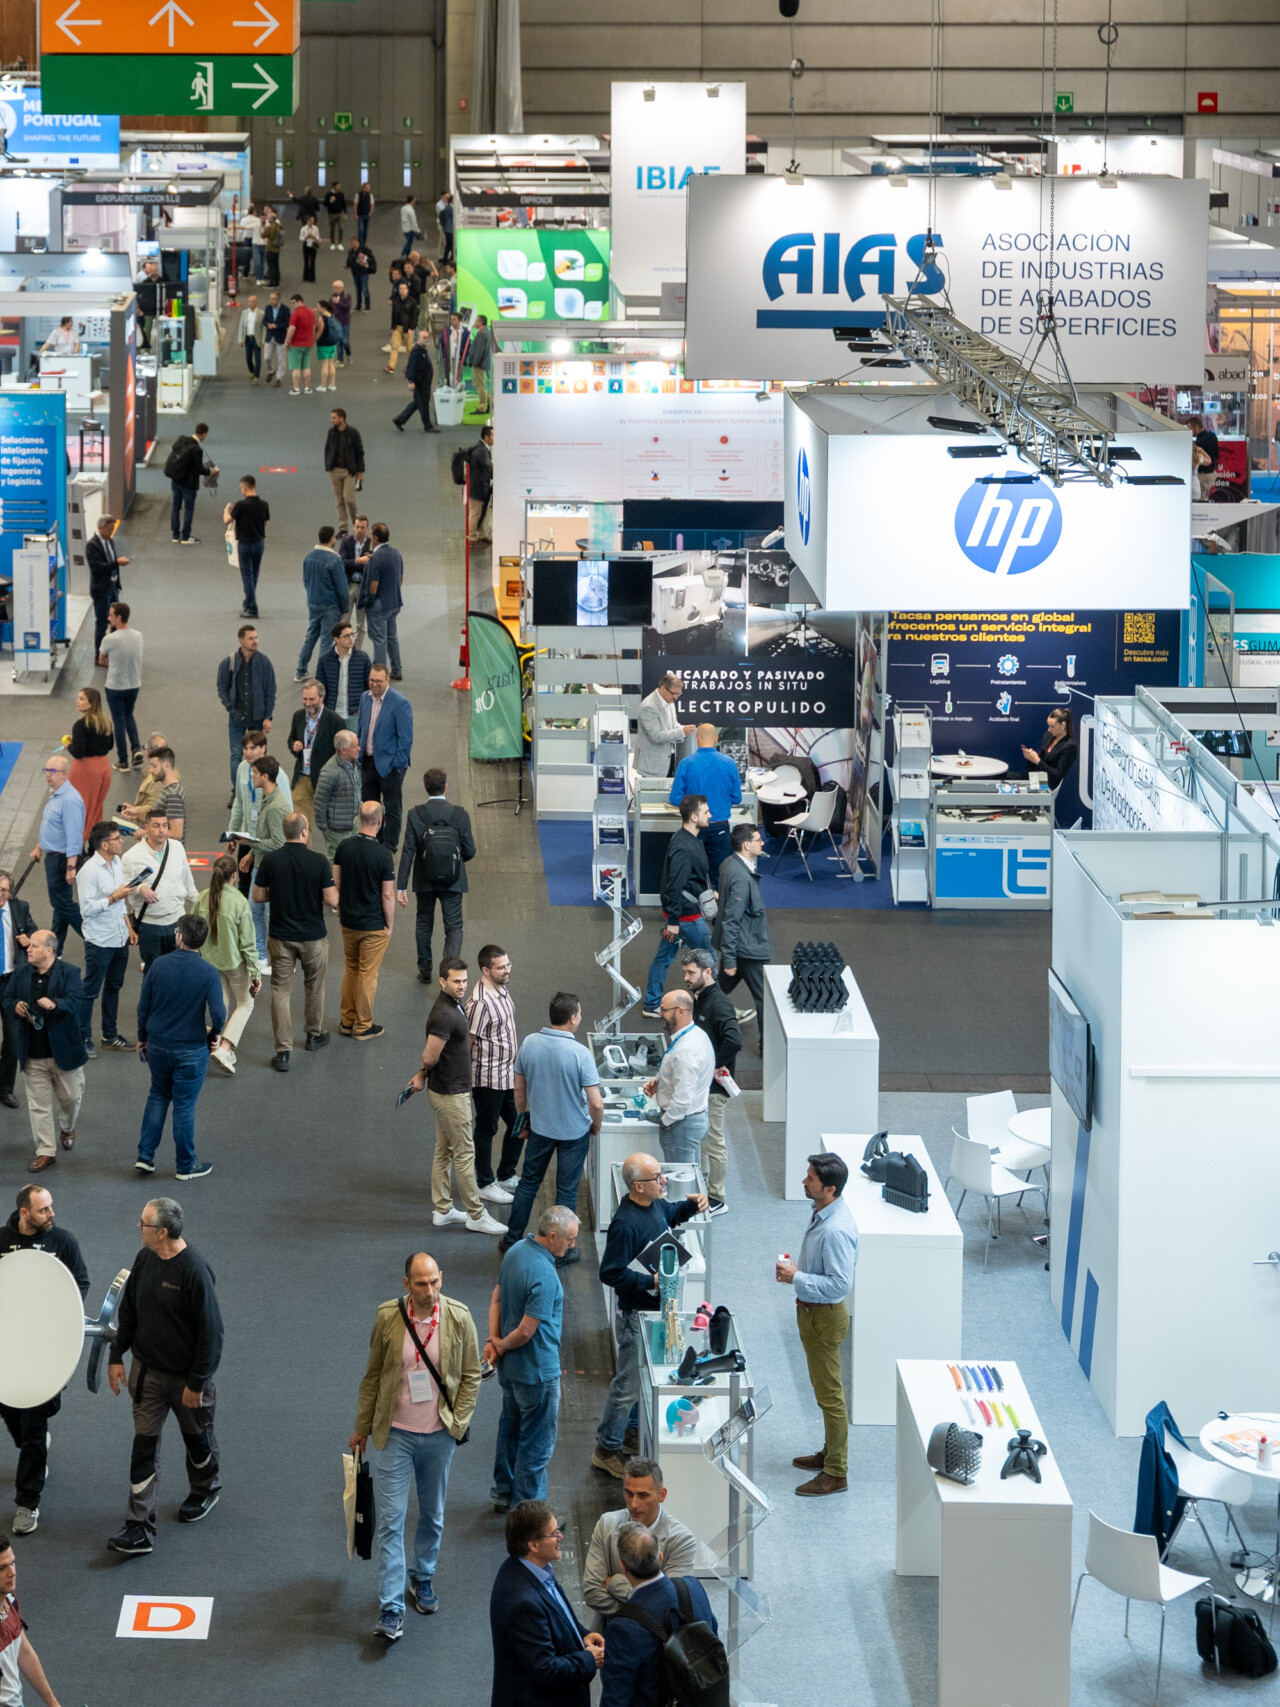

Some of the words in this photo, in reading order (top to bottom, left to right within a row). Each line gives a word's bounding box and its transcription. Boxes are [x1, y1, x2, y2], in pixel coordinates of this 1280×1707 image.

[23, 115, 101, 127] PORTUGAL
[23, 134, 52, 142] SHAPING
[55, 134, 71, 142] THE
[74, 134, 101, 142] FUTURE
[95, 195, 133, 203] EUROPLASTIC
[134, 195, 165, 203] INYECCION
[982, 228, 1131, 252] ASOCIACIÓN
[763, 232, 946, 302] AIAS
[982, 262, 1013, 279] DE
[1020, 262, 1164, 281] INDUSTRIAS
[981, 289, 1012, 306] DE
[1019, 289, 1151, 309] ACABADOS
[980, 317, 1012, 334] DE
[1019, 317, 1177, 337] SUPERFICIES
[1, 436, 44, 444] Soluciones
[1, 446, 48, 456] inteligentes
[1, 456, 10, 465] de
[12, 456, 43, 466] fijación,
[1, 467, 41, 477] ingeniería
[7, 476, 43, 487] logística.
[965, 471, 1054, 575] hp
[891, 612, 931, 622] Tacsa
[935, 612, 1007, 623] pensamos
[1011, 612, 1028, 622] en
[1032, 611, 1074, 623] global
[885, 622, 956, 632] ofrecemos
[959, 622, 978, 632] un
[981, 621, 1035, 632] servicio
[1039, 621, 1092, 634] integral
[905, 632, 967, 641] nuestros
[970, 632, 1026, 642] clientes
[1124, 649, 1154, 657] Descubre
[1155, 649, 1170, 657] más
[1133, 655, 1168, 663] tacsa.com
[743, 670, 751, 680] Y
[757, 670, 826, 680] PASIVADO
[684, 681, 752, 690] TRABAJOS
[759, 681, 770, 690] IN
[778, 681, 808, 690] SITU
[676, 702, 826, 714] LECTROPULIDO
[131, 1601, 196, 1632] D
